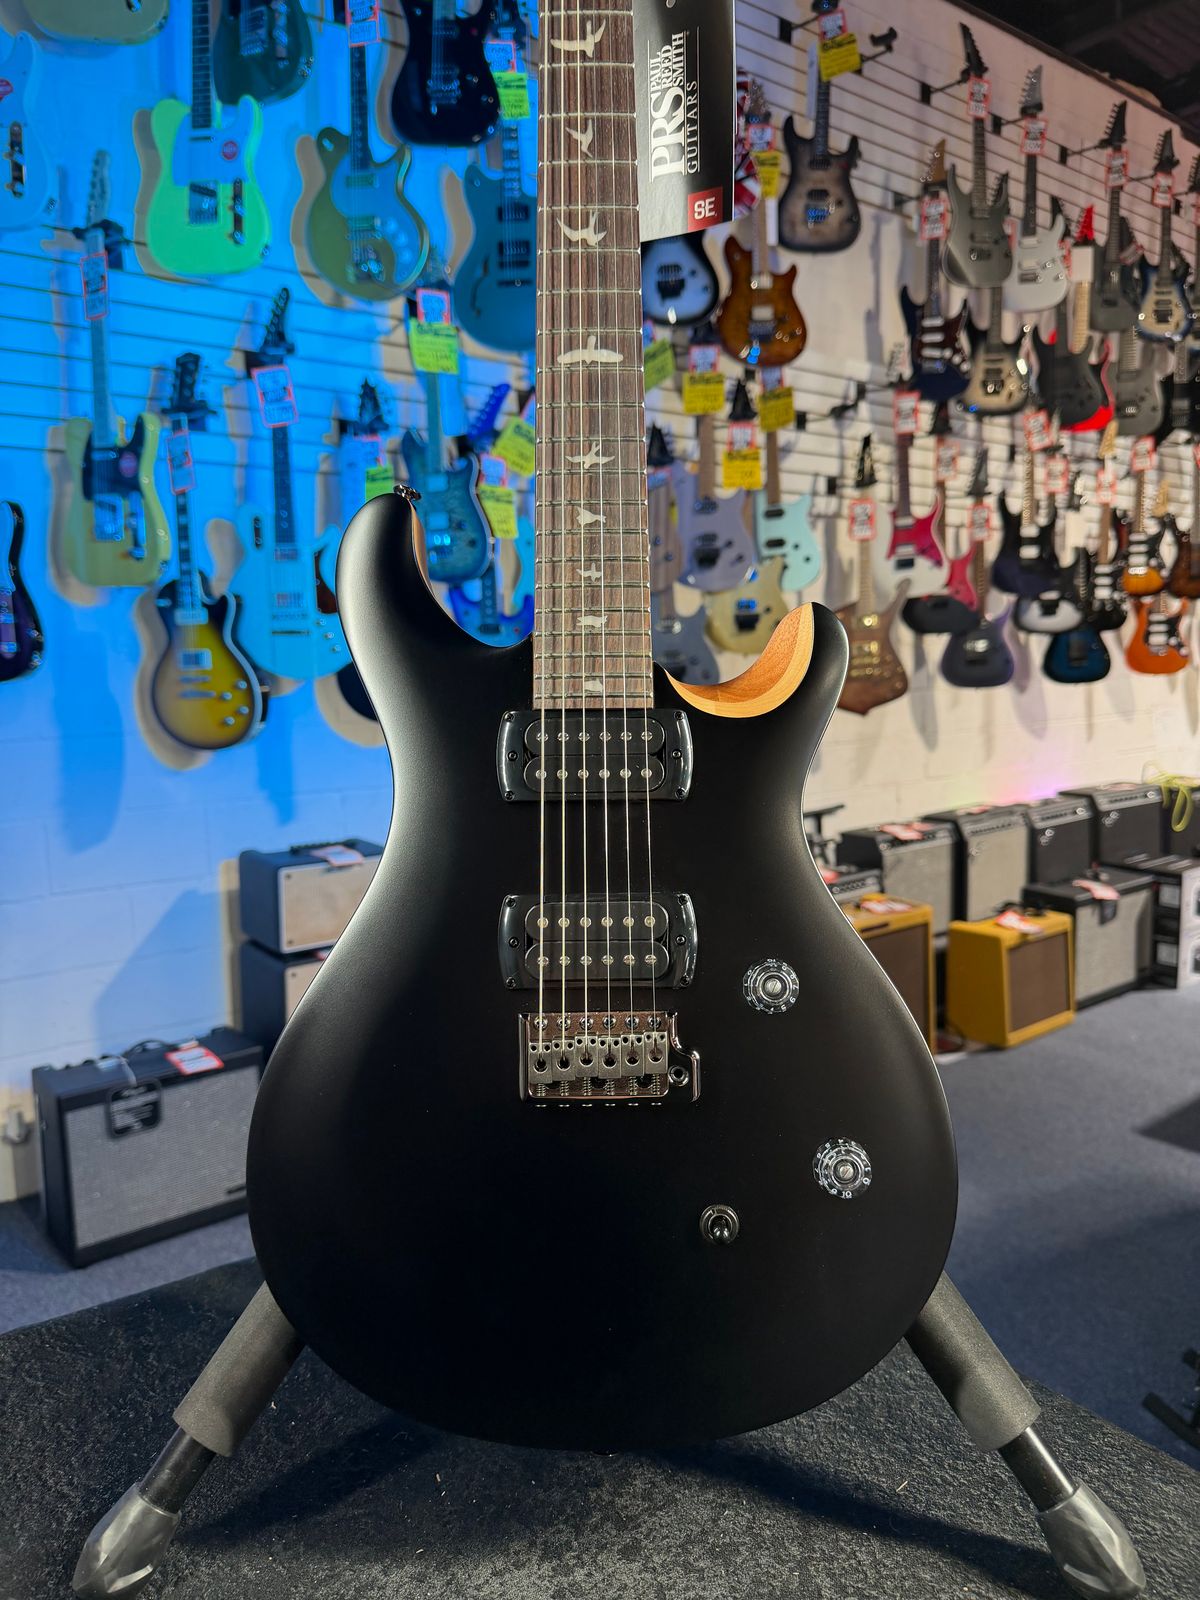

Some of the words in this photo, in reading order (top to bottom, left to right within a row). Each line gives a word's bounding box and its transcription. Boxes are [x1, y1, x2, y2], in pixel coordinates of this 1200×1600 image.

[650, 51, 661, 92] PAUL
[661, 45, 672, 89] REED
[672, 32, 683, 87] SMITH
[651, 87, 684, 183] PRS
[687, 81, 698, 174] GUITARS
[694, 197, 715, 220] SE
